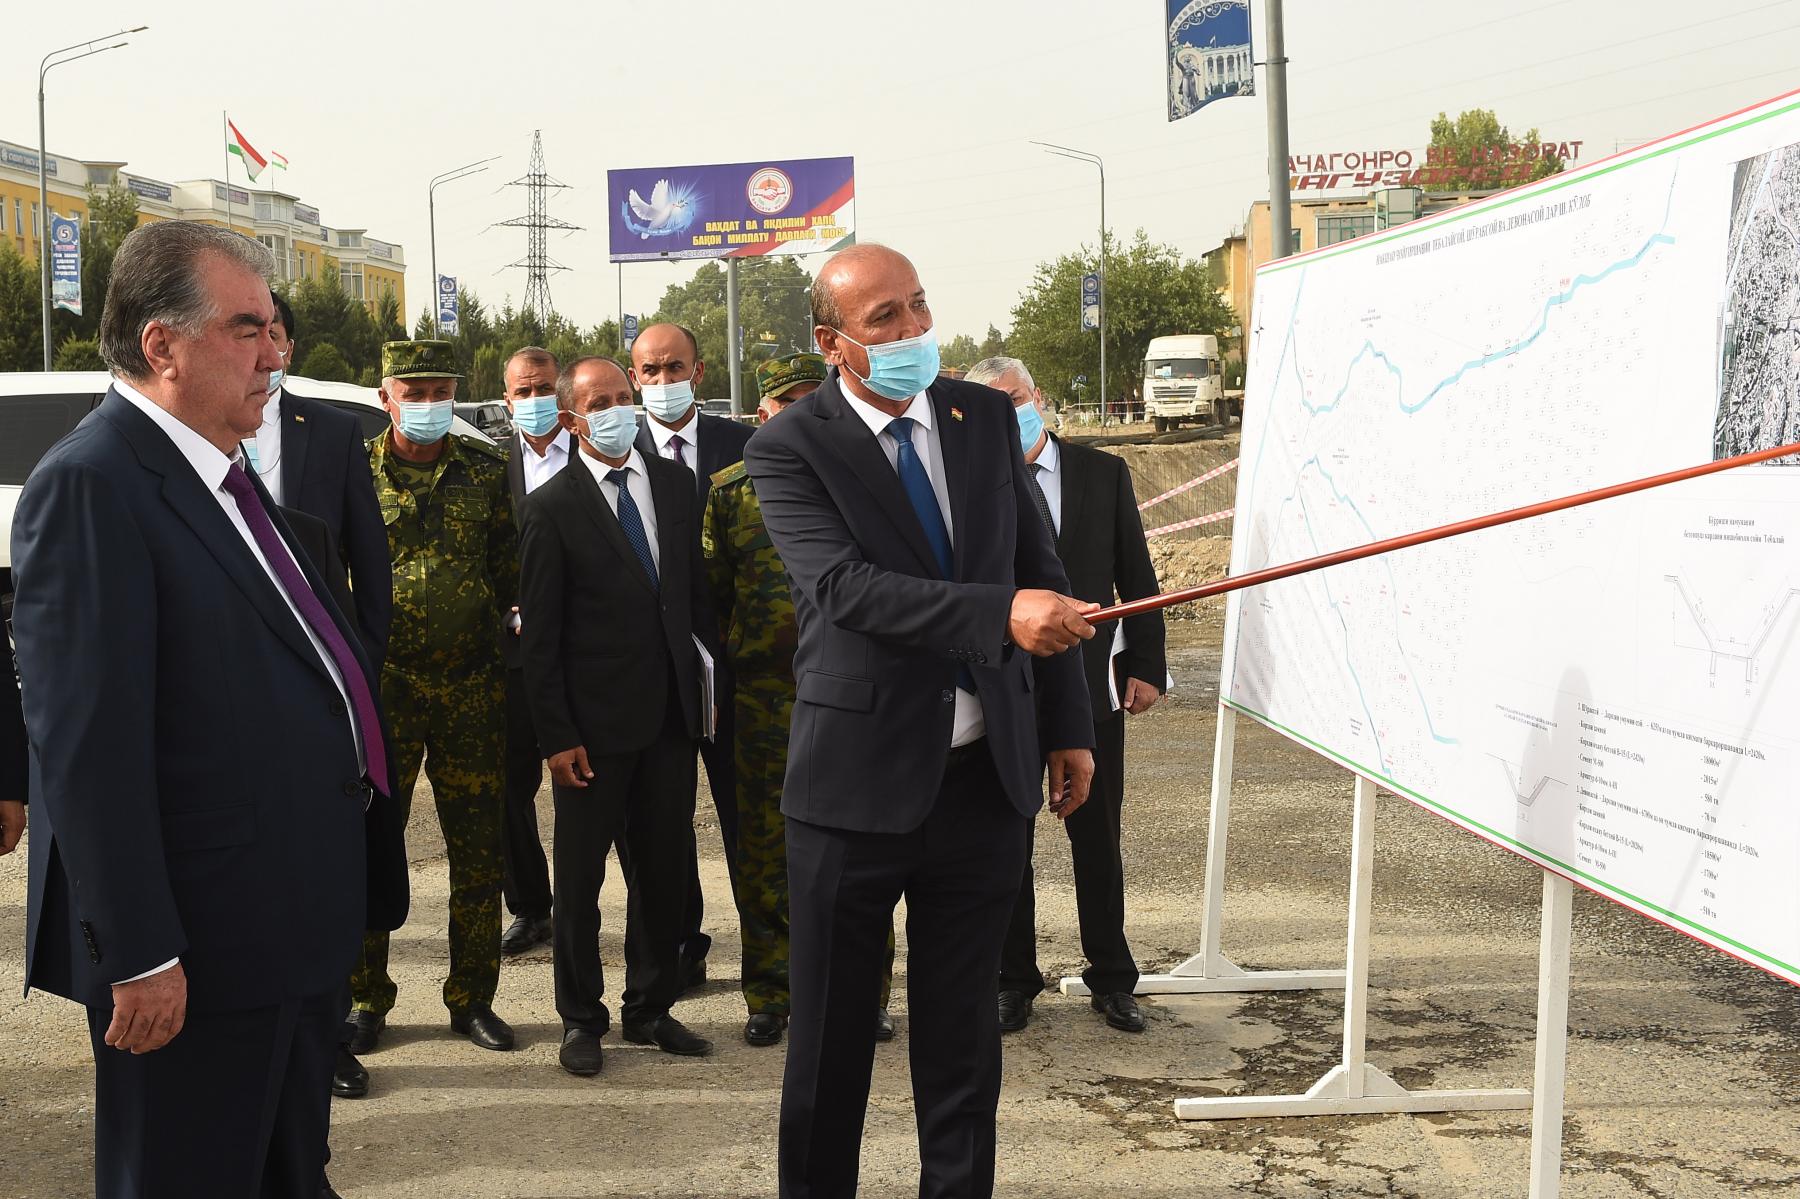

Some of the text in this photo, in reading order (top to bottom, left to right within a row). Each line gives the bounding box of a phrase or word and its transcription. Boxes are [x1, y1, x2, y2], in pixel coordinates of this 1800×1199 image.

[1287, 150, 1412, 174] АЧАГОНРО
[1545, 204, 1558, 220] ДАР
[705, 221, 740, 232] ВАҲДАТ
[746, 219, 758, 230] ВА
[692, 235, 722, 246] БАҚОИ
[728, 232, 769, 244] МИЛЛАТУ
